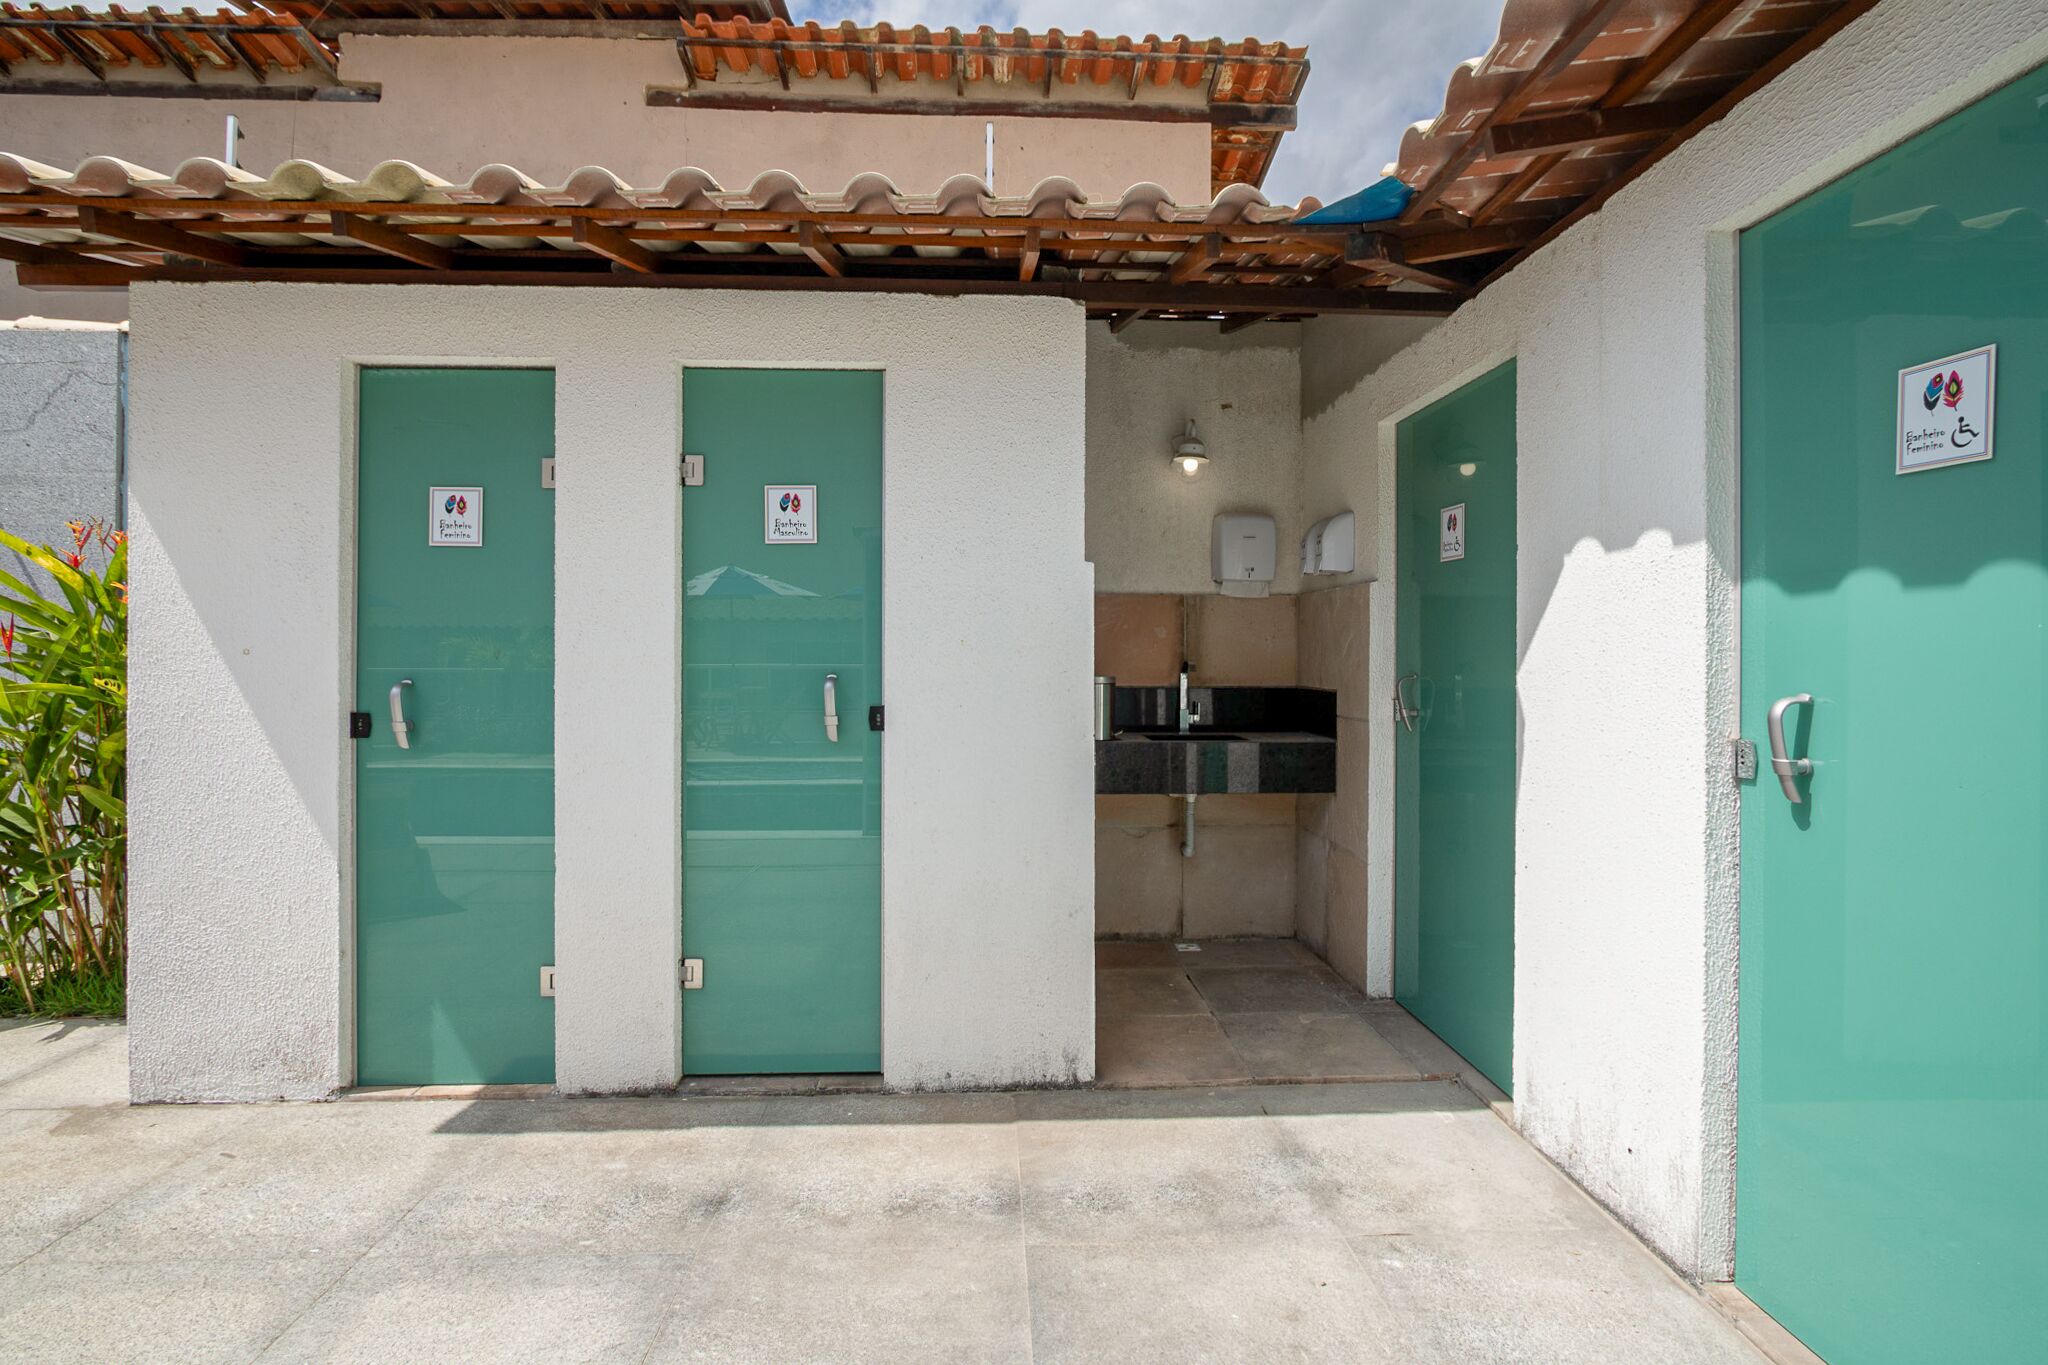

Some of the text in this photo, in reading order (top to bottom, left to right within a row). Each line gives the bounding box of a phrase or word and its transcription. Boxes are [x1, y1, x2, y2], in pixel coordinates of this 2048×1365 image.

[1906, 428, 1946, 443] Banheiro
[1906, 441, 1944, 455] Feminino
[440, 519, 472, 529] Banheiro
[775, 518, 807, 528] Banheiro
[440, 529, 471, 539] Feminino
[773, 527, 808, 536] Masculino
